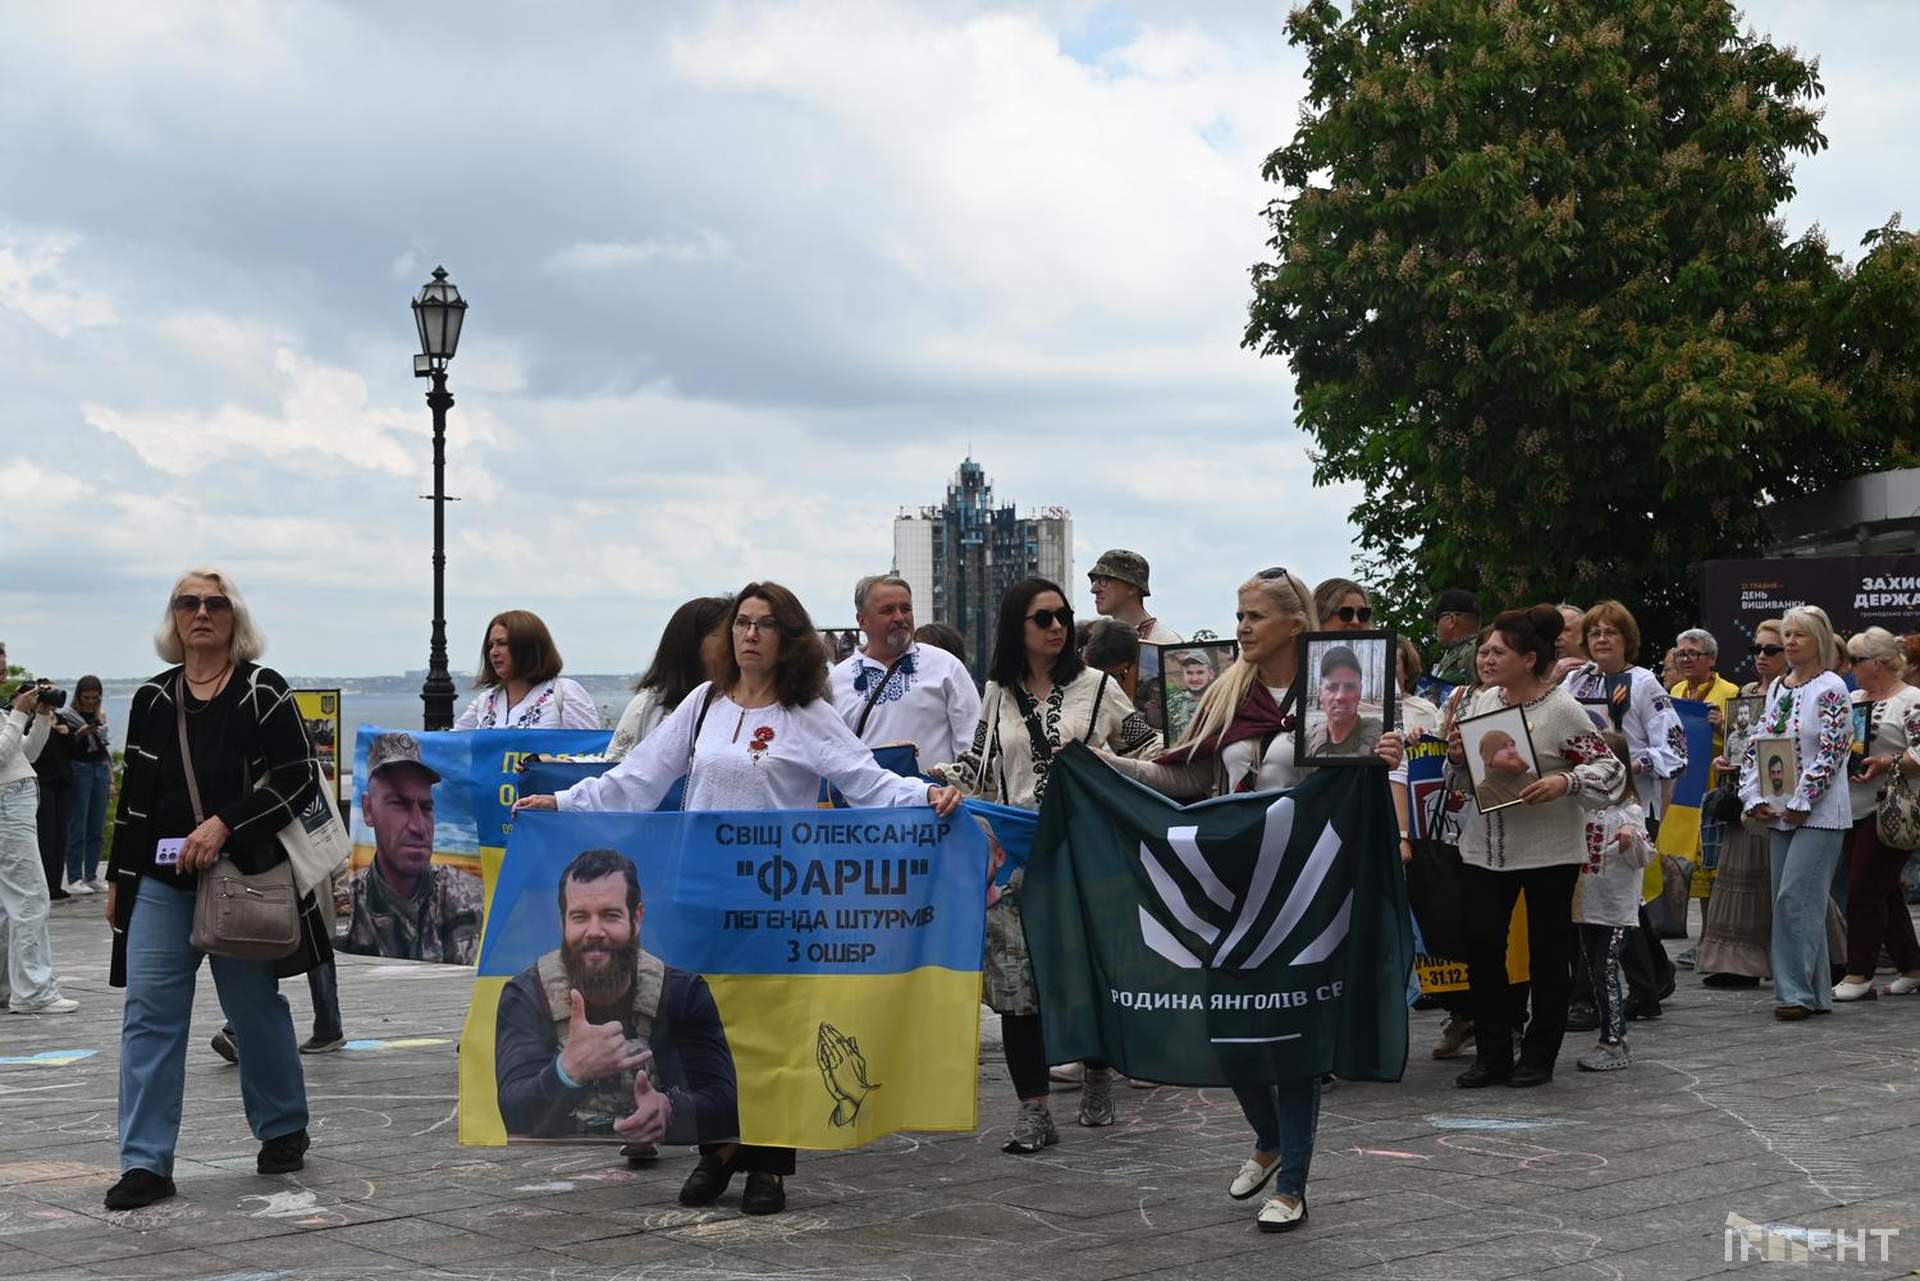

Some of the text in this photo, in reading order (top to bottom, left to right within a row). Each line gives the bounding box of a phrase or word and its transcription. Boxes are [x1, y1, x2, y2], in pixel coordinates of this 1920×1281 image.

[1741, 591, 1768, 600] ДЕНЬ
[736, 855, 929, 900] "ФАРШ"
[723, 909, 829, 933] ЛЕГЕНДА
[807, 943, 876, 963] ОШБР
[1110, 988, 1204, 1010] РОДИНА
[1210, 991, 1308, 1010] ЯНГОЛІВ
